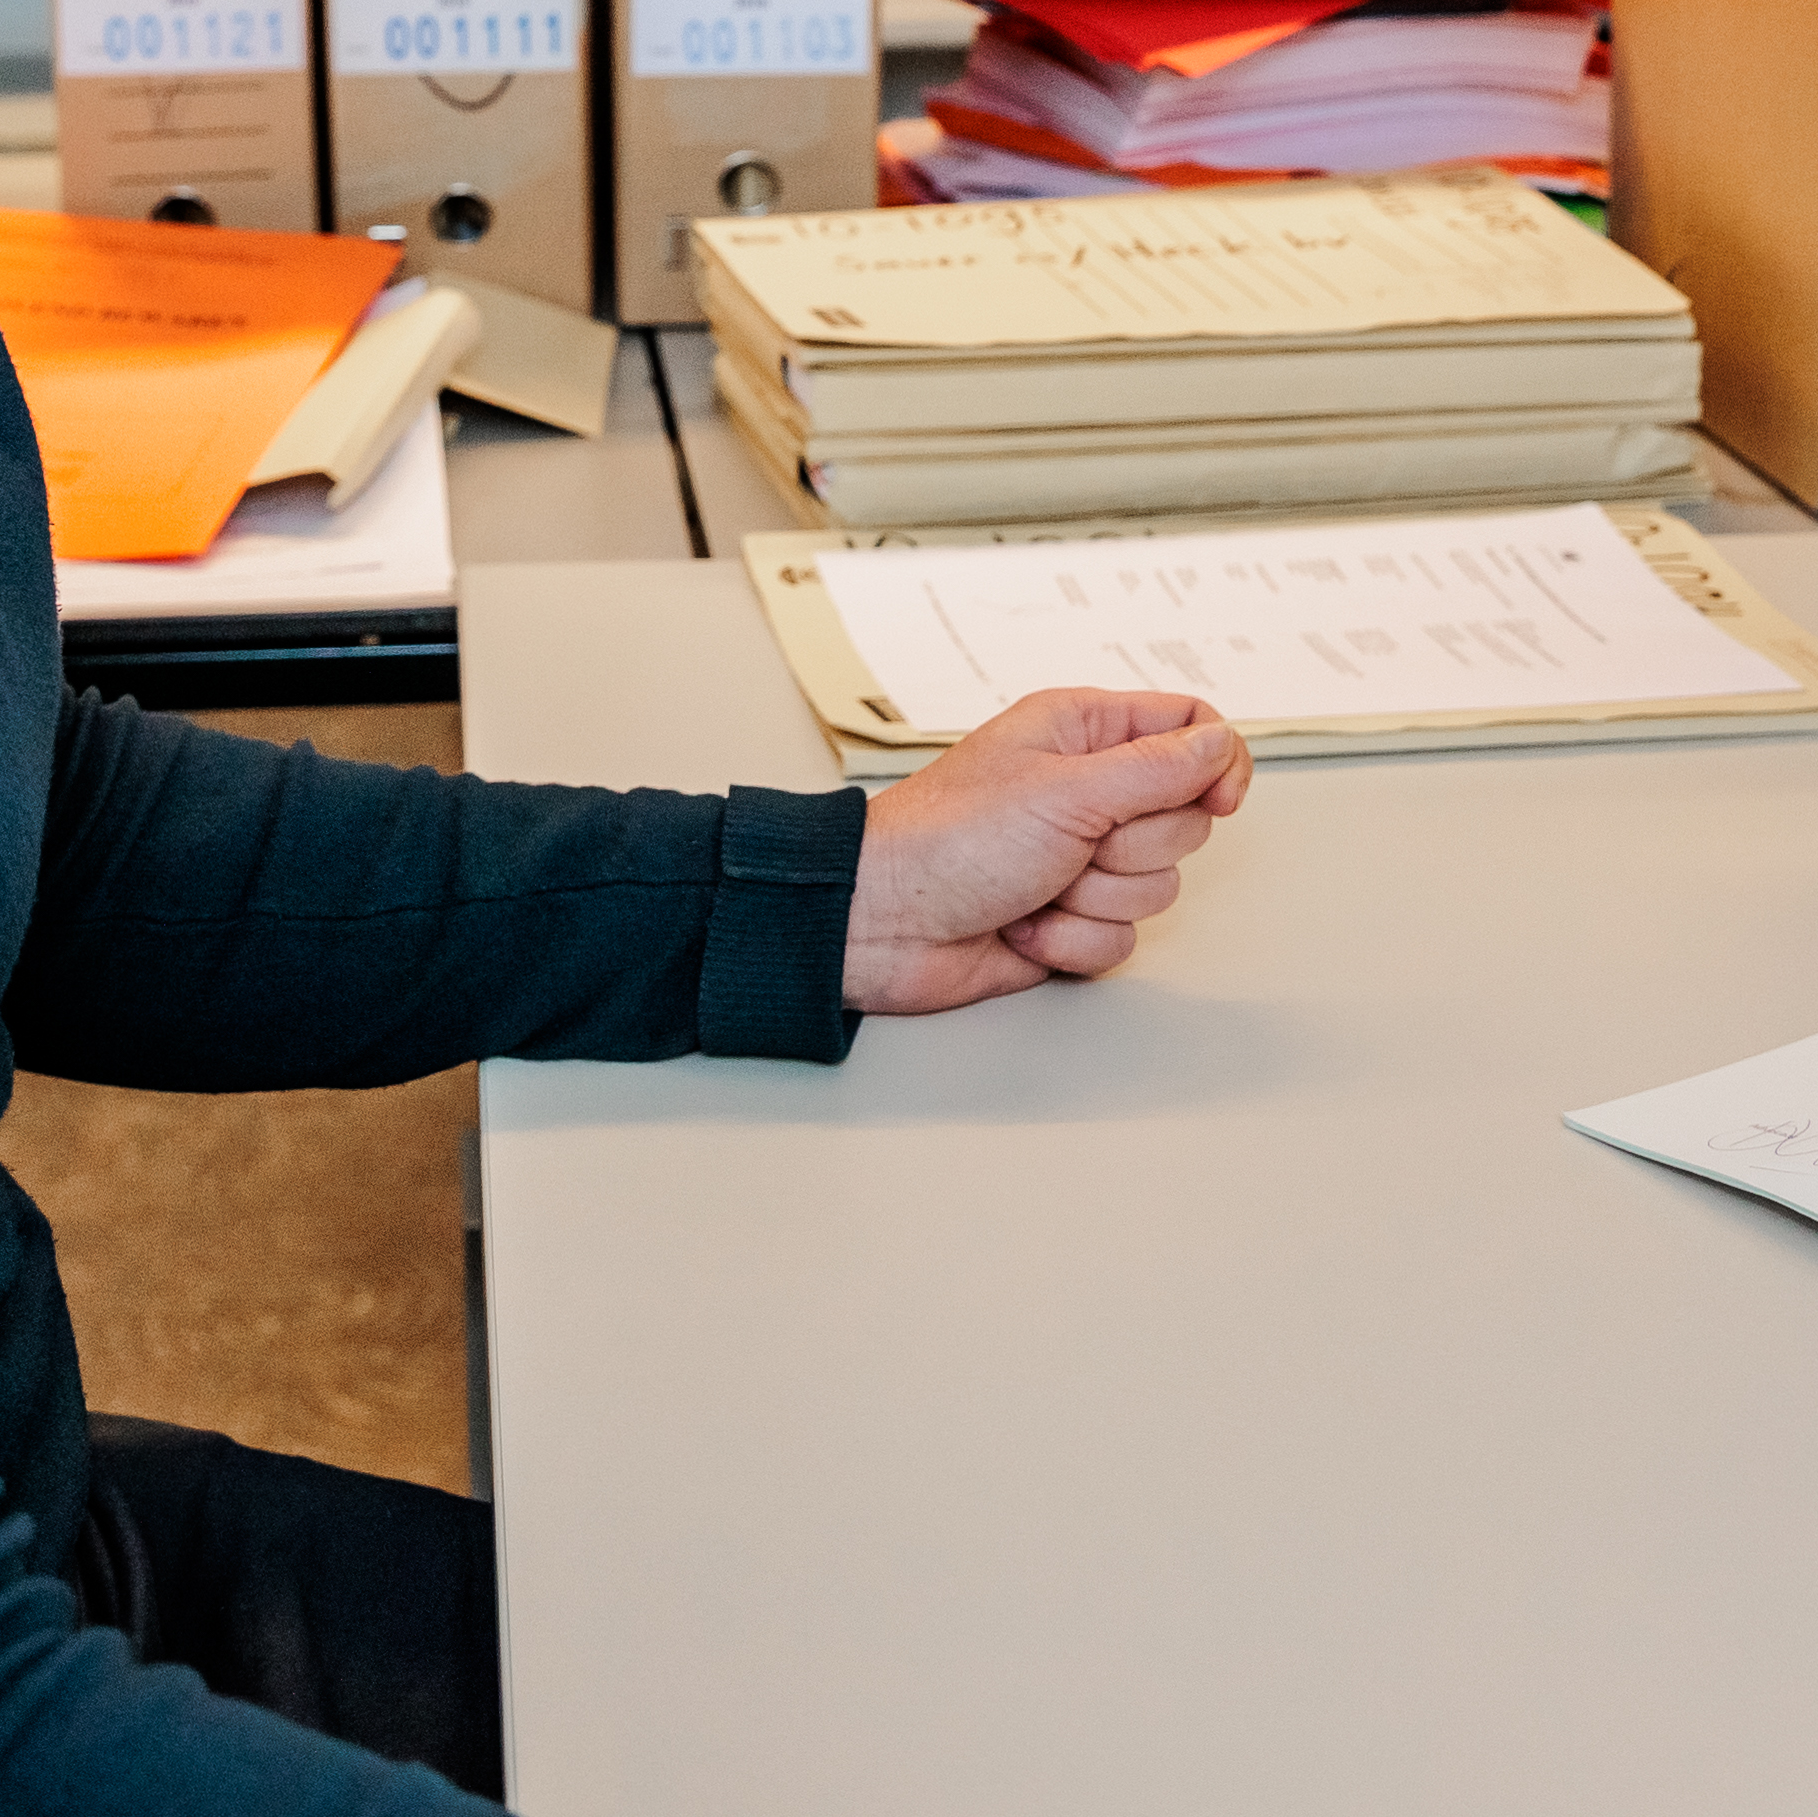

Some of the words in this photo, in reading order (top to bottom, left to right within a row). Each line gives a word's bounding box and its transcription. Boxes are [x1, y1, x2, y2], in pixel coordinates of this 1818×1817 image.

[103, 10, 284, 62] 001121
[384, 12, 563, 62] 001111
[683, 15, 856, 64] 001103
